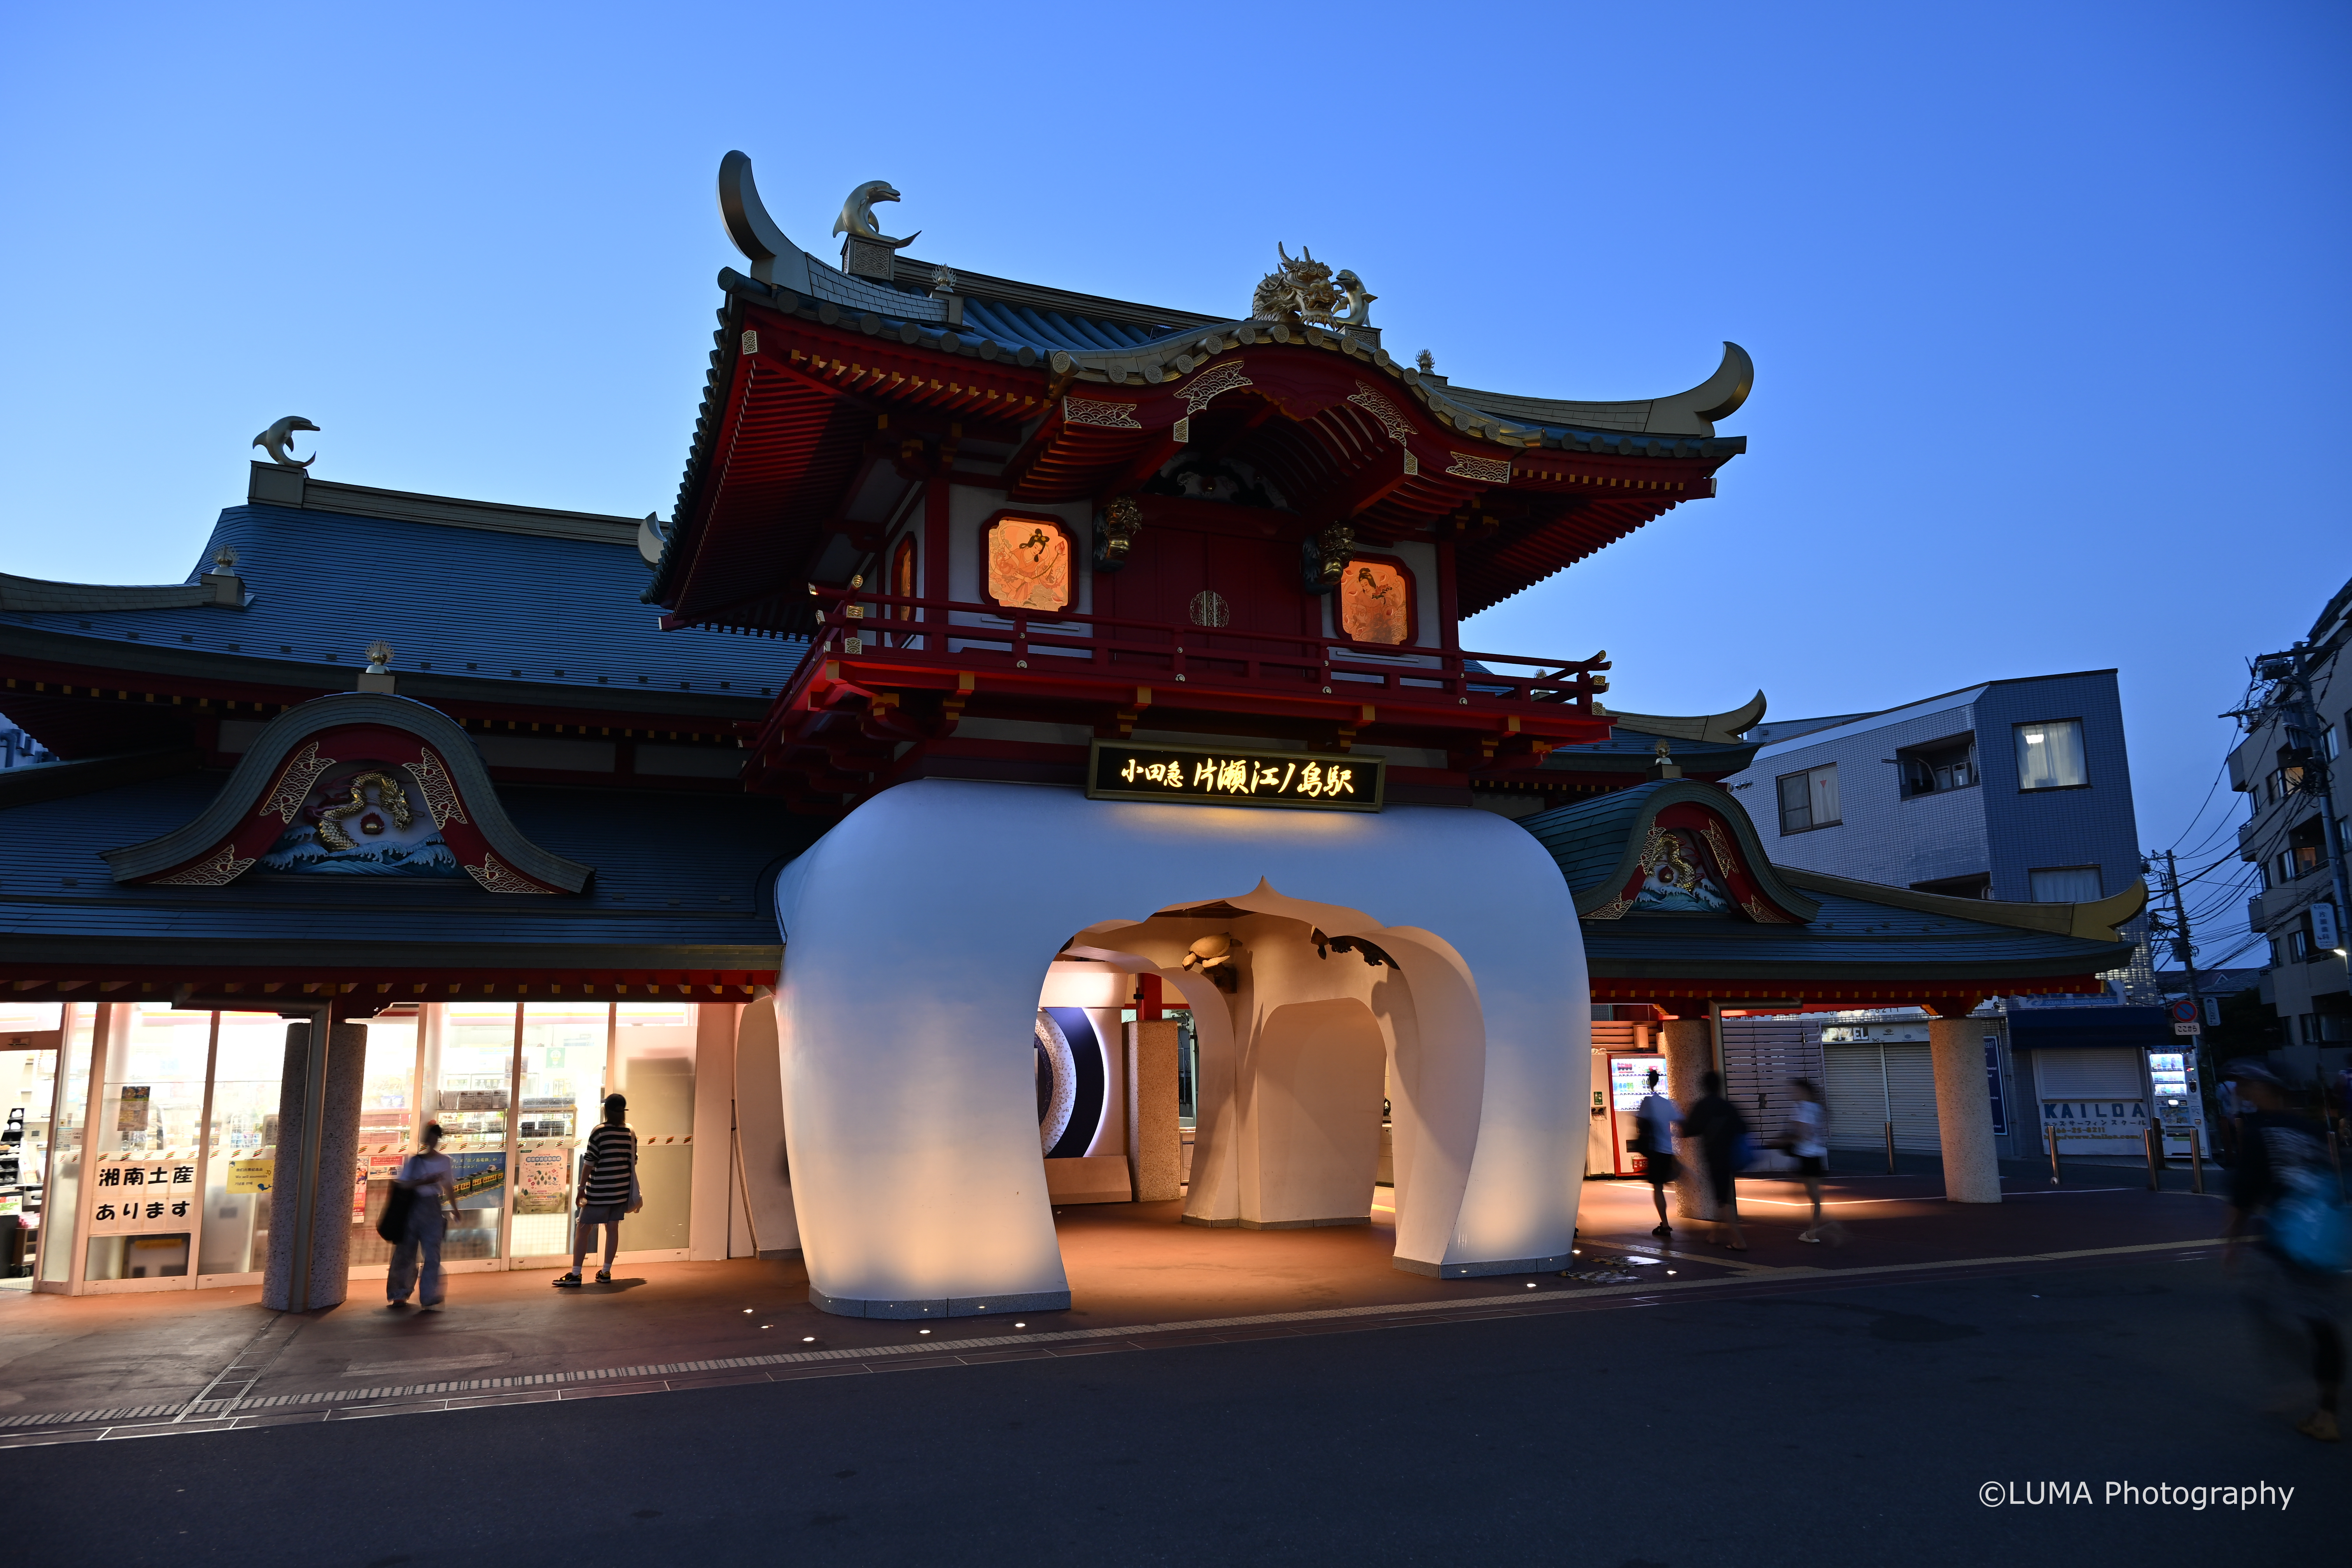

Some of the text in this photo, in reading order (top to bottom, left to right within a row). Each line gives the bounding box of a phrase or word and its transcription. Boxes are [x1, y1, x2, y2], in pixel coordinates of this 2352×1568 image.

[1122, 758, 1354, 797] 小田急 片瀬江ノ島駅
[1829, 1027, 1868, 1041] PYZEL
[2044, 1103, 2145, 1118] KAILOA
[99, 1166, 194, 1186] 湘南土産
[96, 1201, 190, 1221] あります
